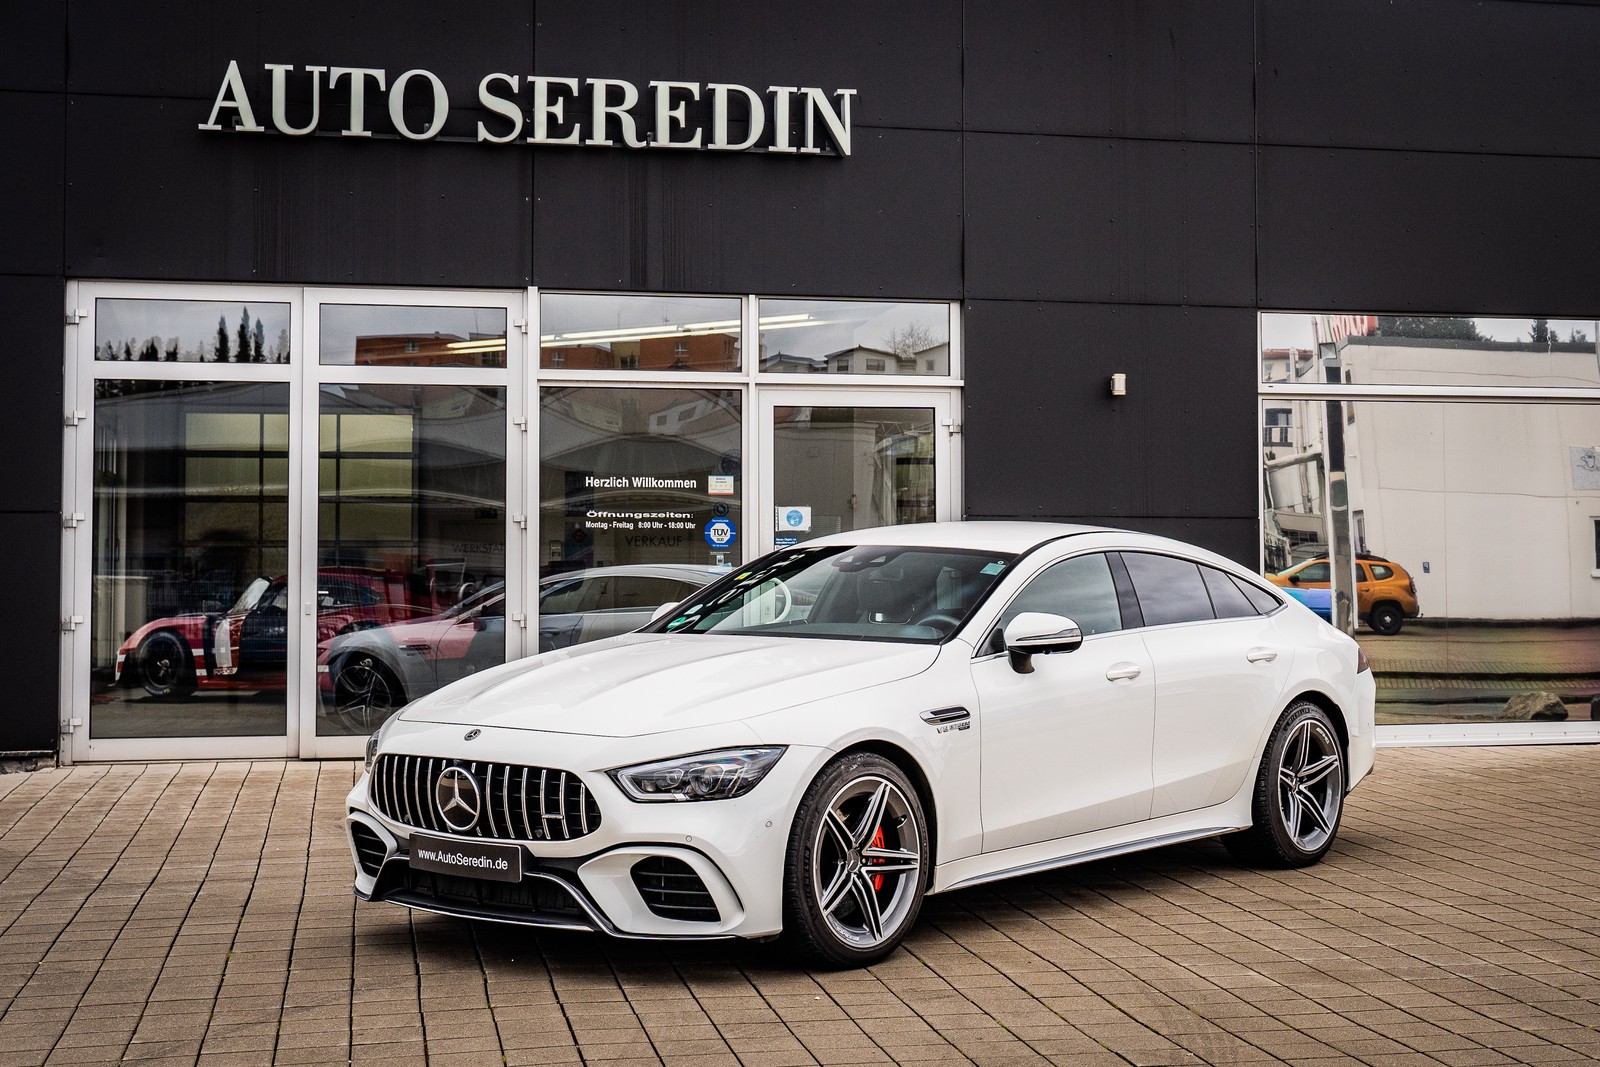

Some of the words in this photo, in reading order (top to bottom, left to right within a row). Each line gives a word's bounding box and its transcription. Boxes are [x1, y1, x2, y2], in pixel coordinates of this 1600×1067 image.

[198, 60, 449, 141] AUTO
[477, 72, 858, 156] SEREDIN
[585, 476, 629, 488] Herzlich
[632, 477, 697, 489] Willkommen
[586, 510, 694, 519] Öffnungszeiten:
[585, 521, 608, 530] Montag
[612, 521, 634, 530] Freitag
[637, 521, 651, 529] 8:00
[652, 521, 663, 529] Uhr
[625, 535, 683, 547] VERKAUF
[418, 849, 509, 870] www.AutoSeredin.de
